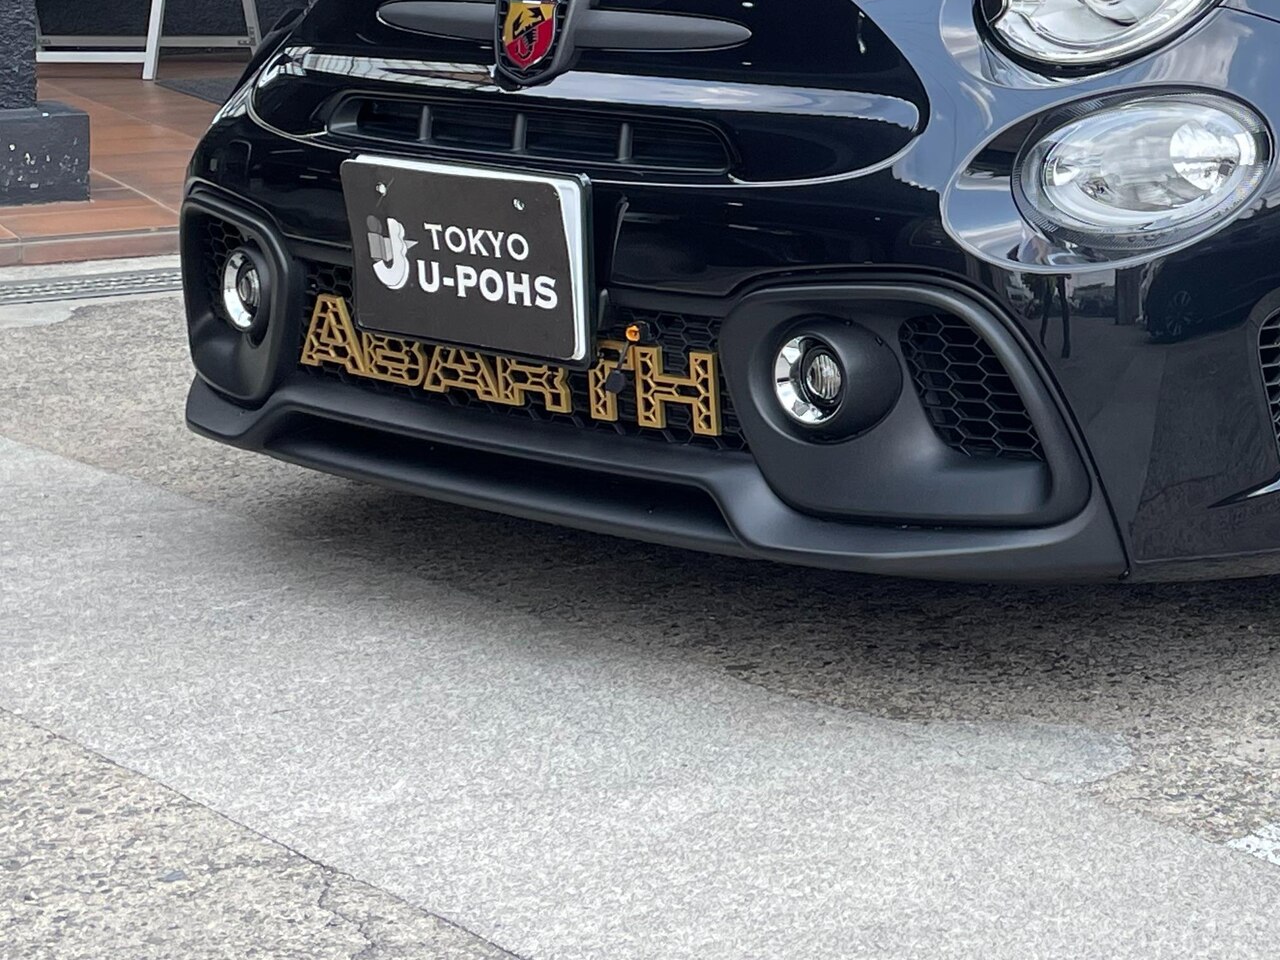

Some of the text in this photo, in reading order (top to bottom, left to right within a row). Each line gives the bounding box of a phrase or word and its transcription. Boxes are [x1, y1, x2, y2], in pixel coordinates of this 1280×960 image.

[423, 221, 529, 261] TOKYO
[417, 260, 559, 309] U-POHS
[300, 293, 722, 437] ABARTH
